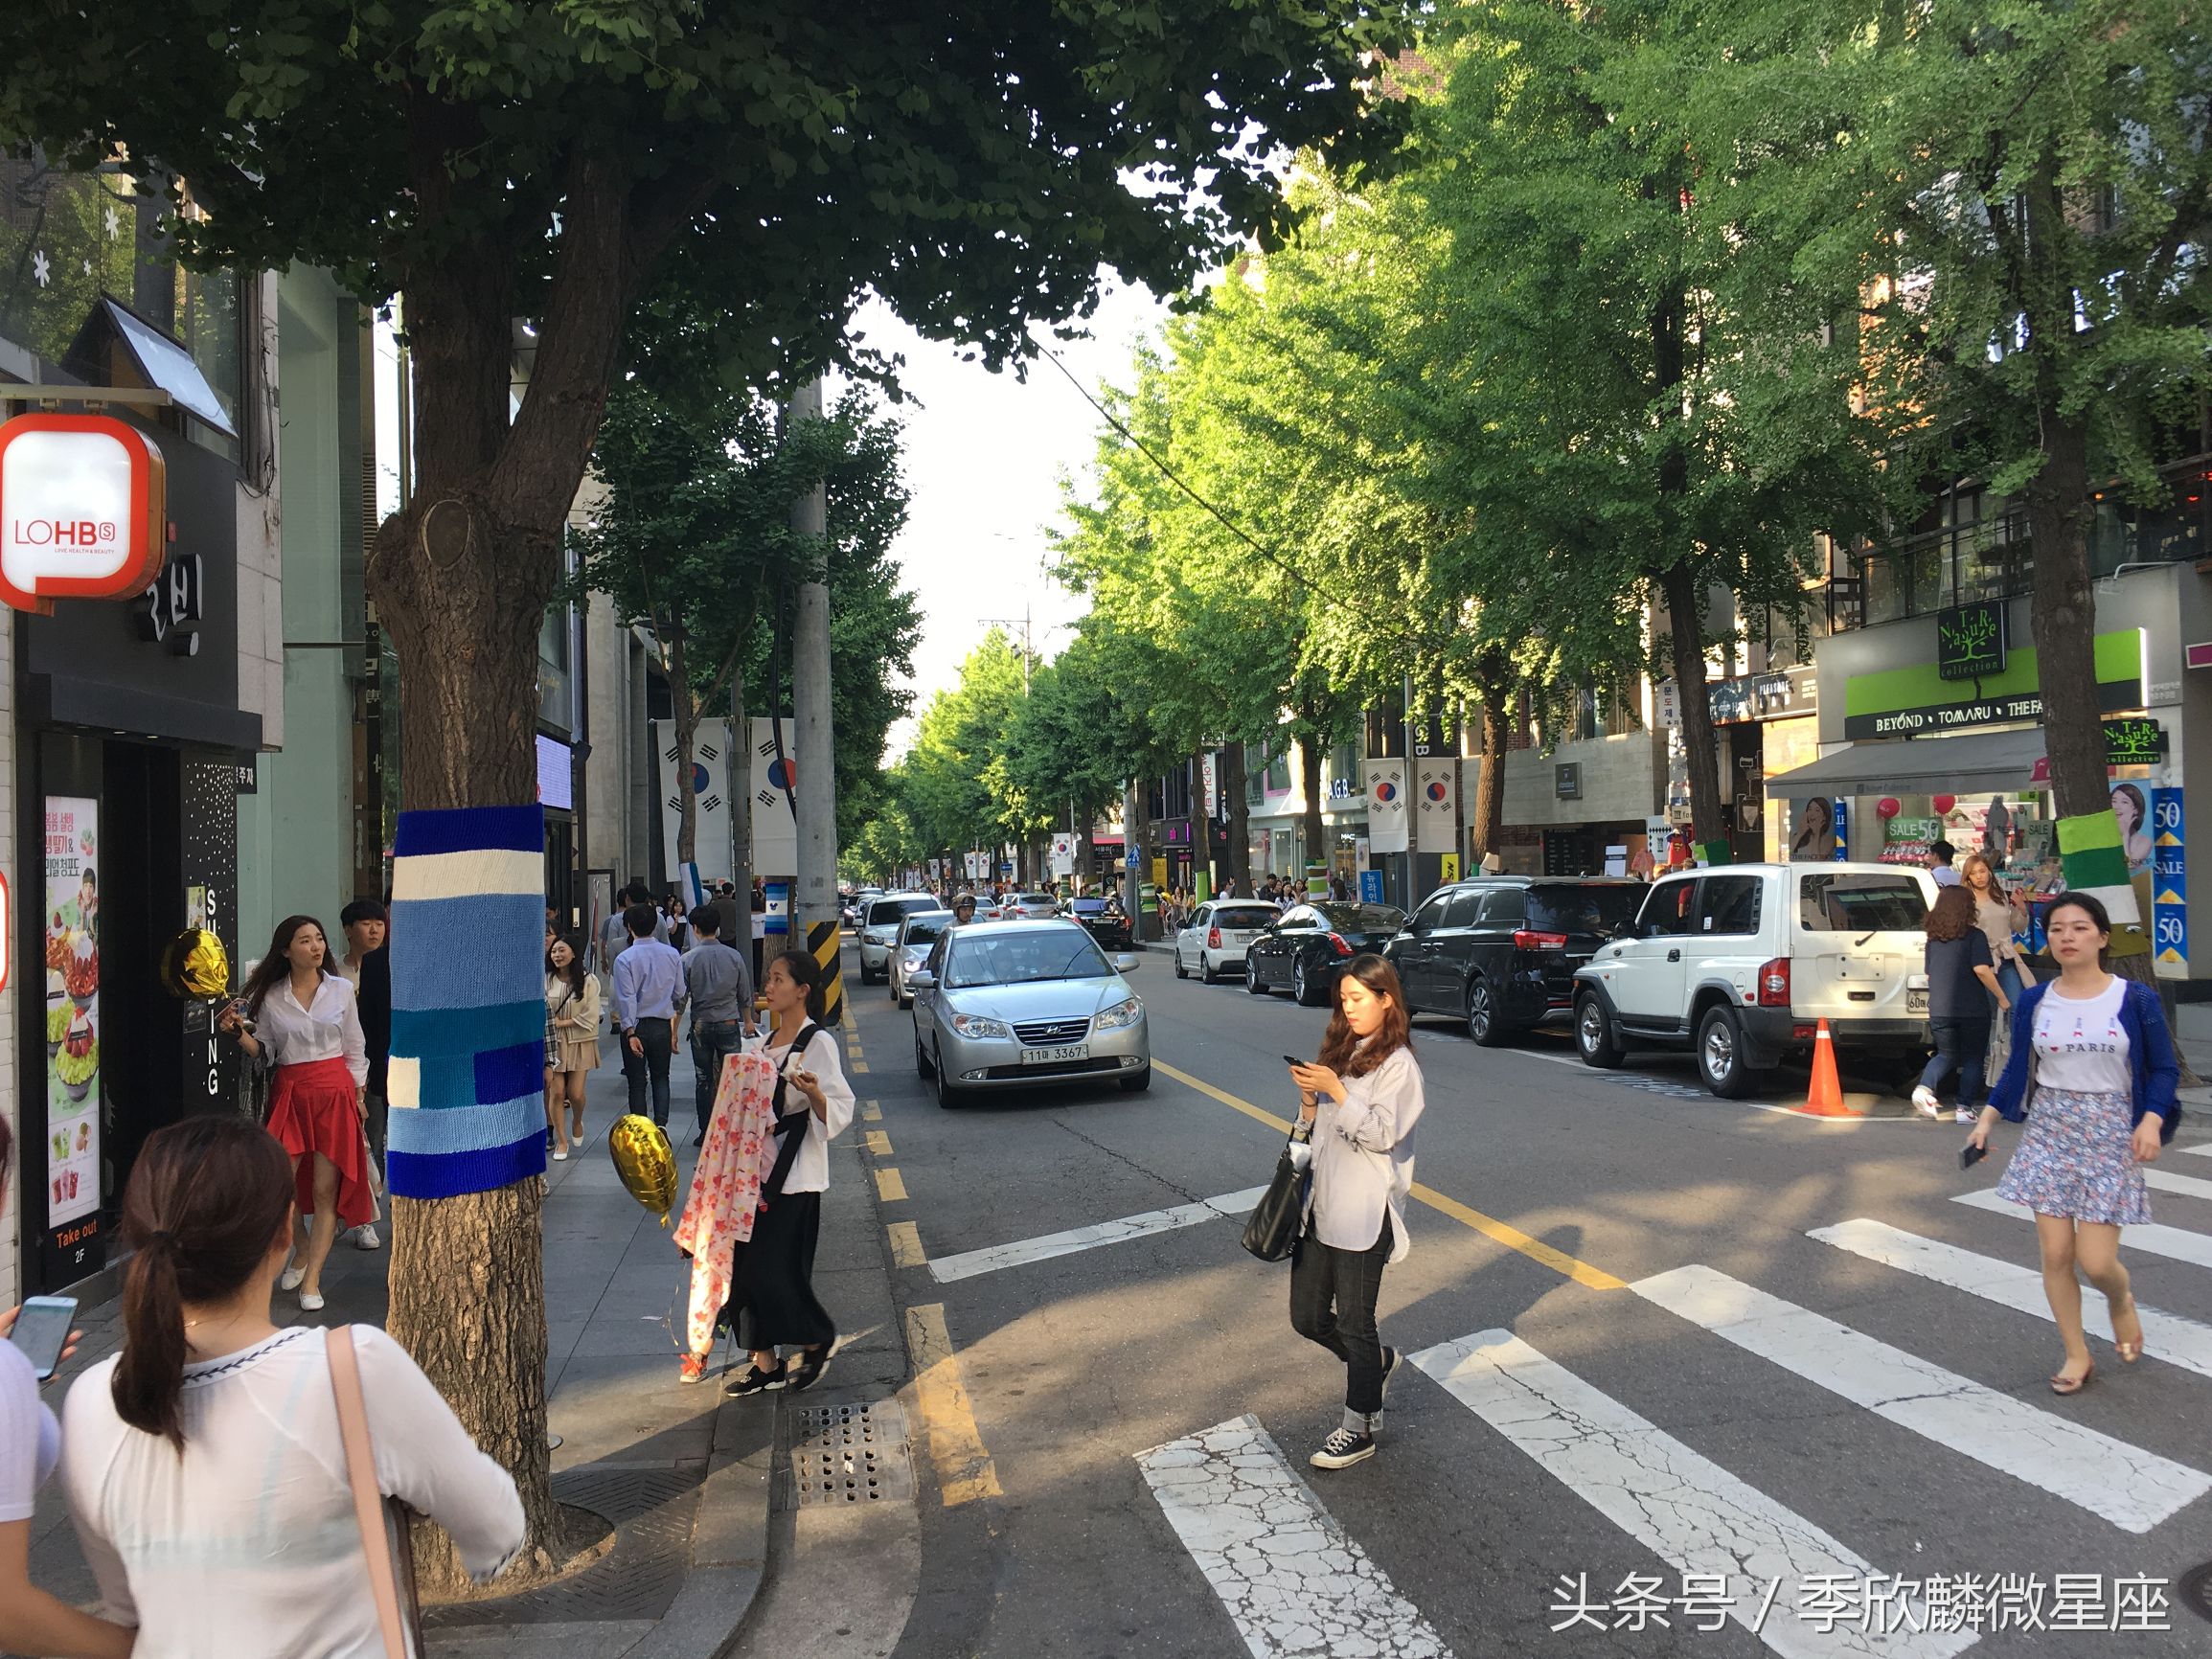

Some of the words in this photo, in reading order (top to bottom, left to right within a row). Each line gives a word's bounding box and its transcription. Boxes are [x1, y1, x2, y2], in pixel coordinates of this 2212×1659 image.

[1941, 661, 1998, 677] collection
[1876, 712, 1923, 732] BEYOND
[1938, 706, 1990, 724] TOMARU
[2106, 755, 2160, 763] collection
[2155, 802, 2180, 829] 50
[1889, 824, 1917, 836] SALE
[2029, 824, 2048, 835] SALE
[2155, 861, 2184, 875] SALE
[2157, 918, 2184, 944] 50
[1055, 1047, 1082, 1059] 3367
[2065, 1042, 2116, 1054] PARIS
[56, 1228, 80, 1249] Take
[82, 1219, 98, 1238] out
[75, 1248, 85, 1263] 2F
